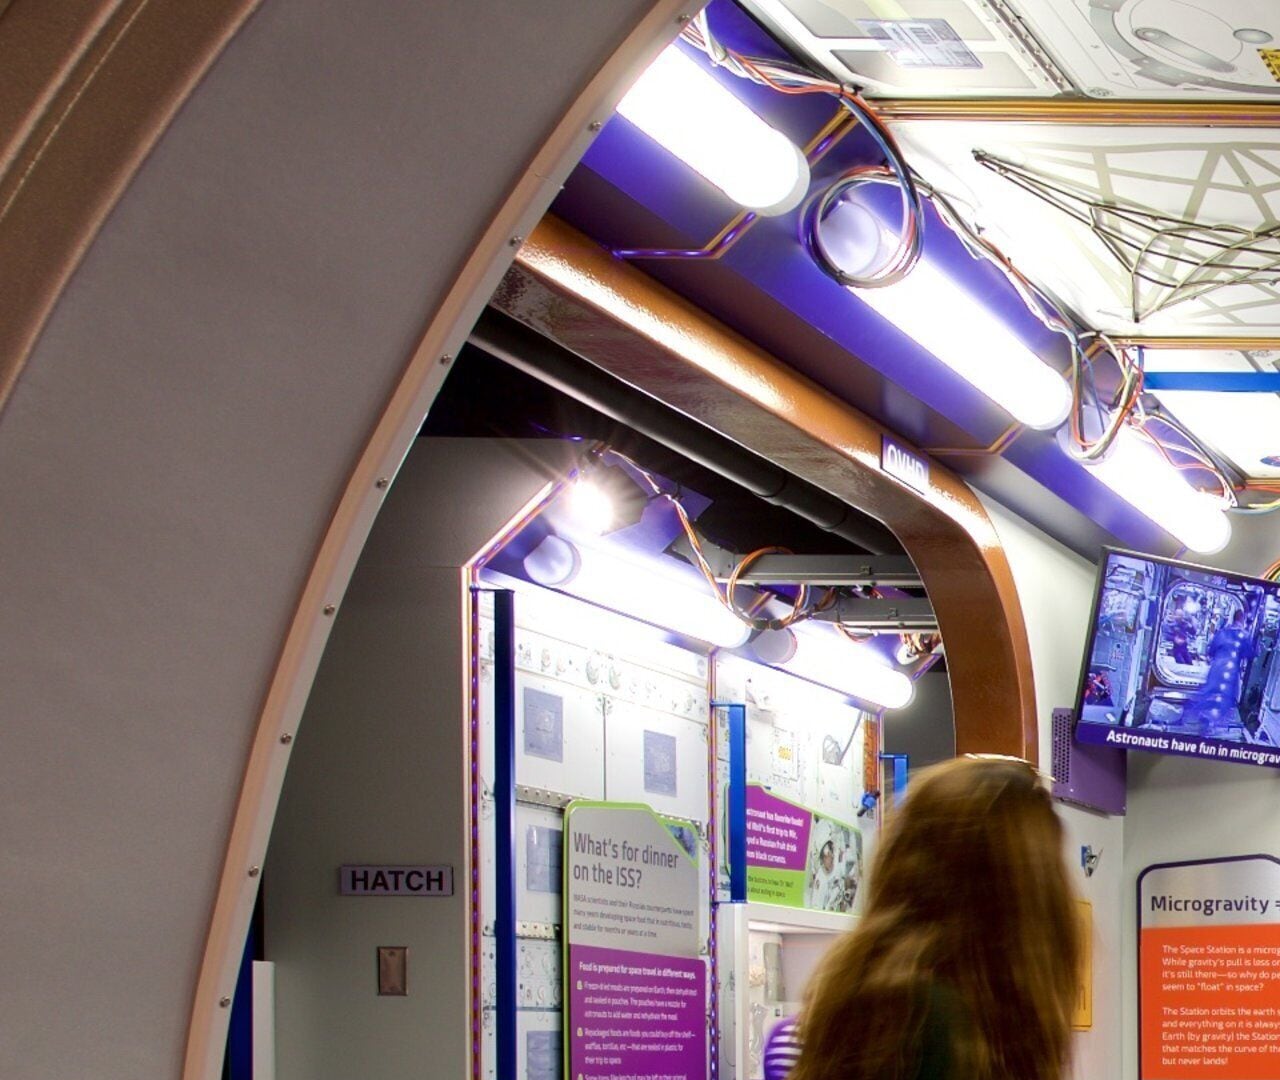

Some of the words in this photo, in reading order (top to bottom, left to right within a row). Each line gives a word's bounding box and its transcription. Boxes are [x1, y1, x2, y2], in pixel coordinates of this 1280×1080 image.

[1106, 729, 1169, 751] Astronauts
[1171, 737, 1197, 753] have
[1199, 741, 1216, 755] fun
[1218, 744, 1228, 756] in
[622, 841, 639, 861] for
[642, 845, 678, 869] dinner
[350, 870, 444, 893] HATCH
[574, 865, 588, 881] on
[592, 863, 612, 884] the
[617, 866, 642, 889] ISS?
[1151, 895, 1269, 915] Microgravity
